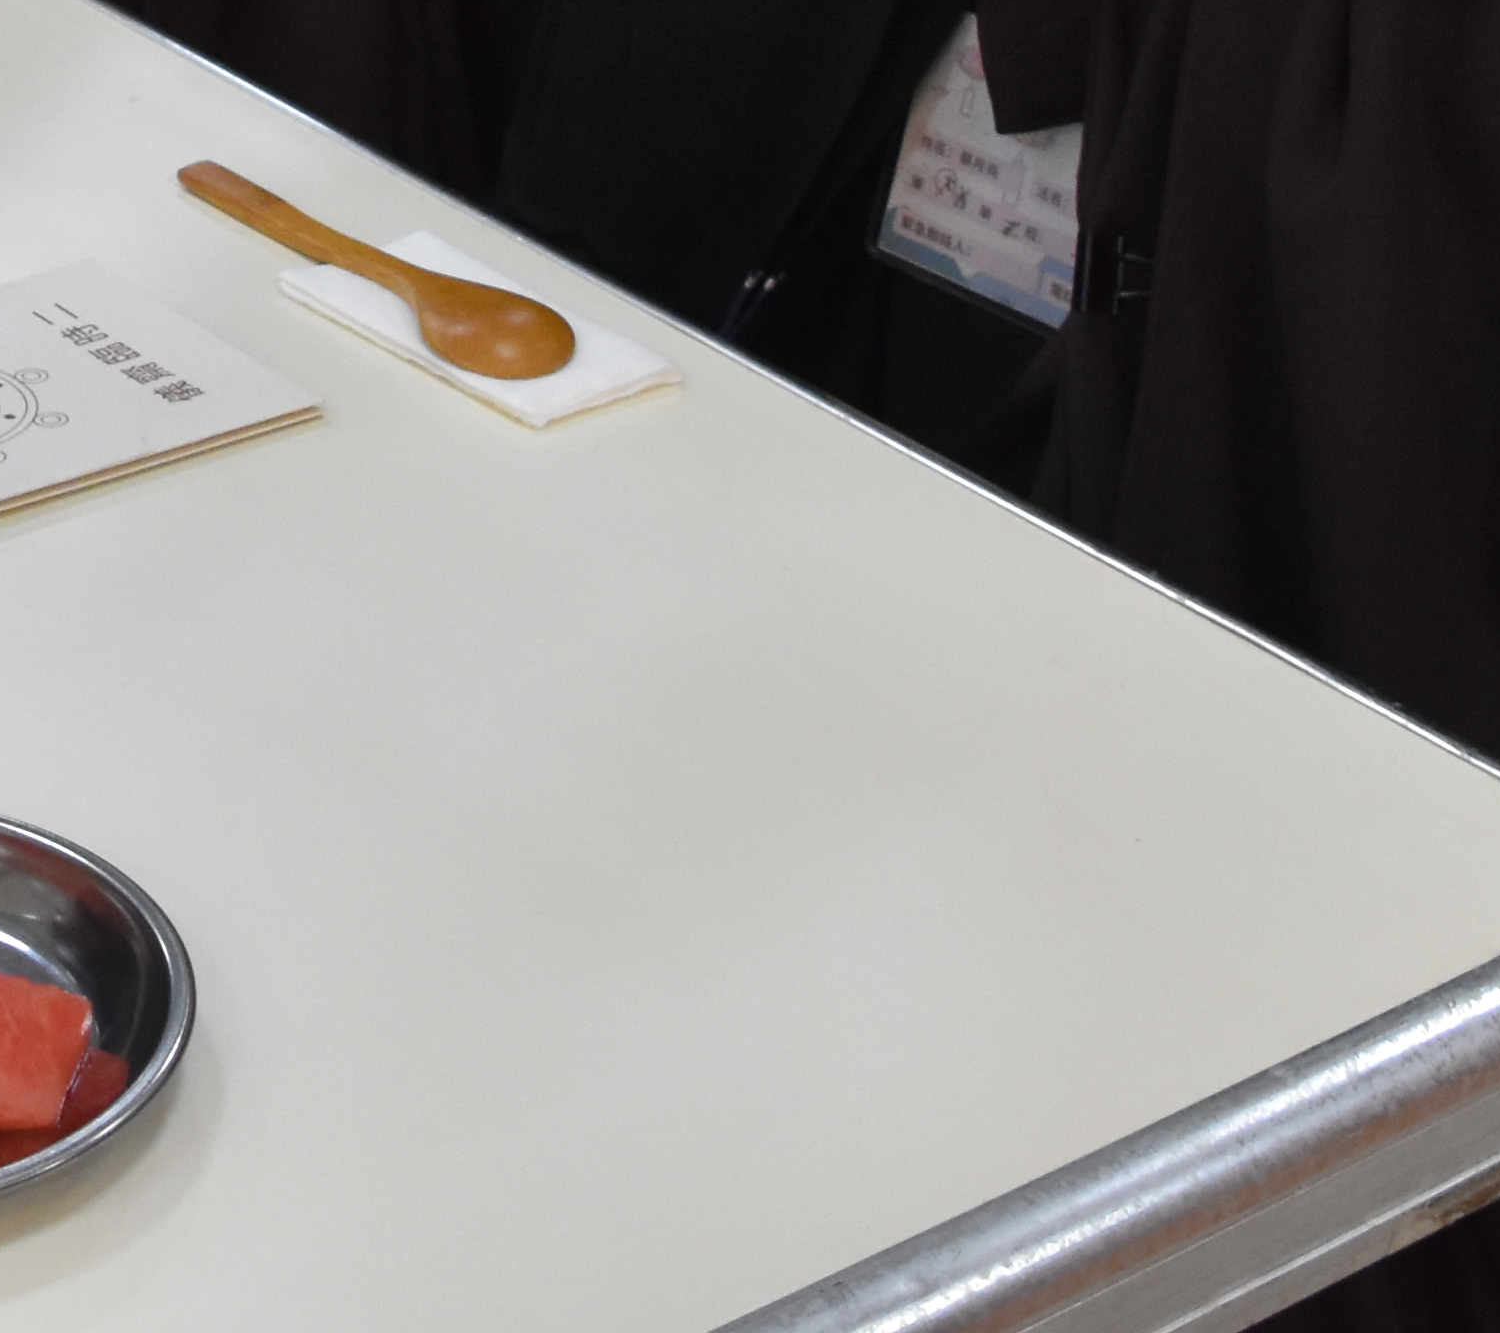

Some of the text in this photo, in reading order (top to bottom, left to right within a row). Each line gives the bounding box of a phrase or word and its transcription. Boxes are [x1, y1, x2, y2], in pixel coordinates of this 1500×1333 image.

[32, 302, 206, 403] 二時臨齋儀
